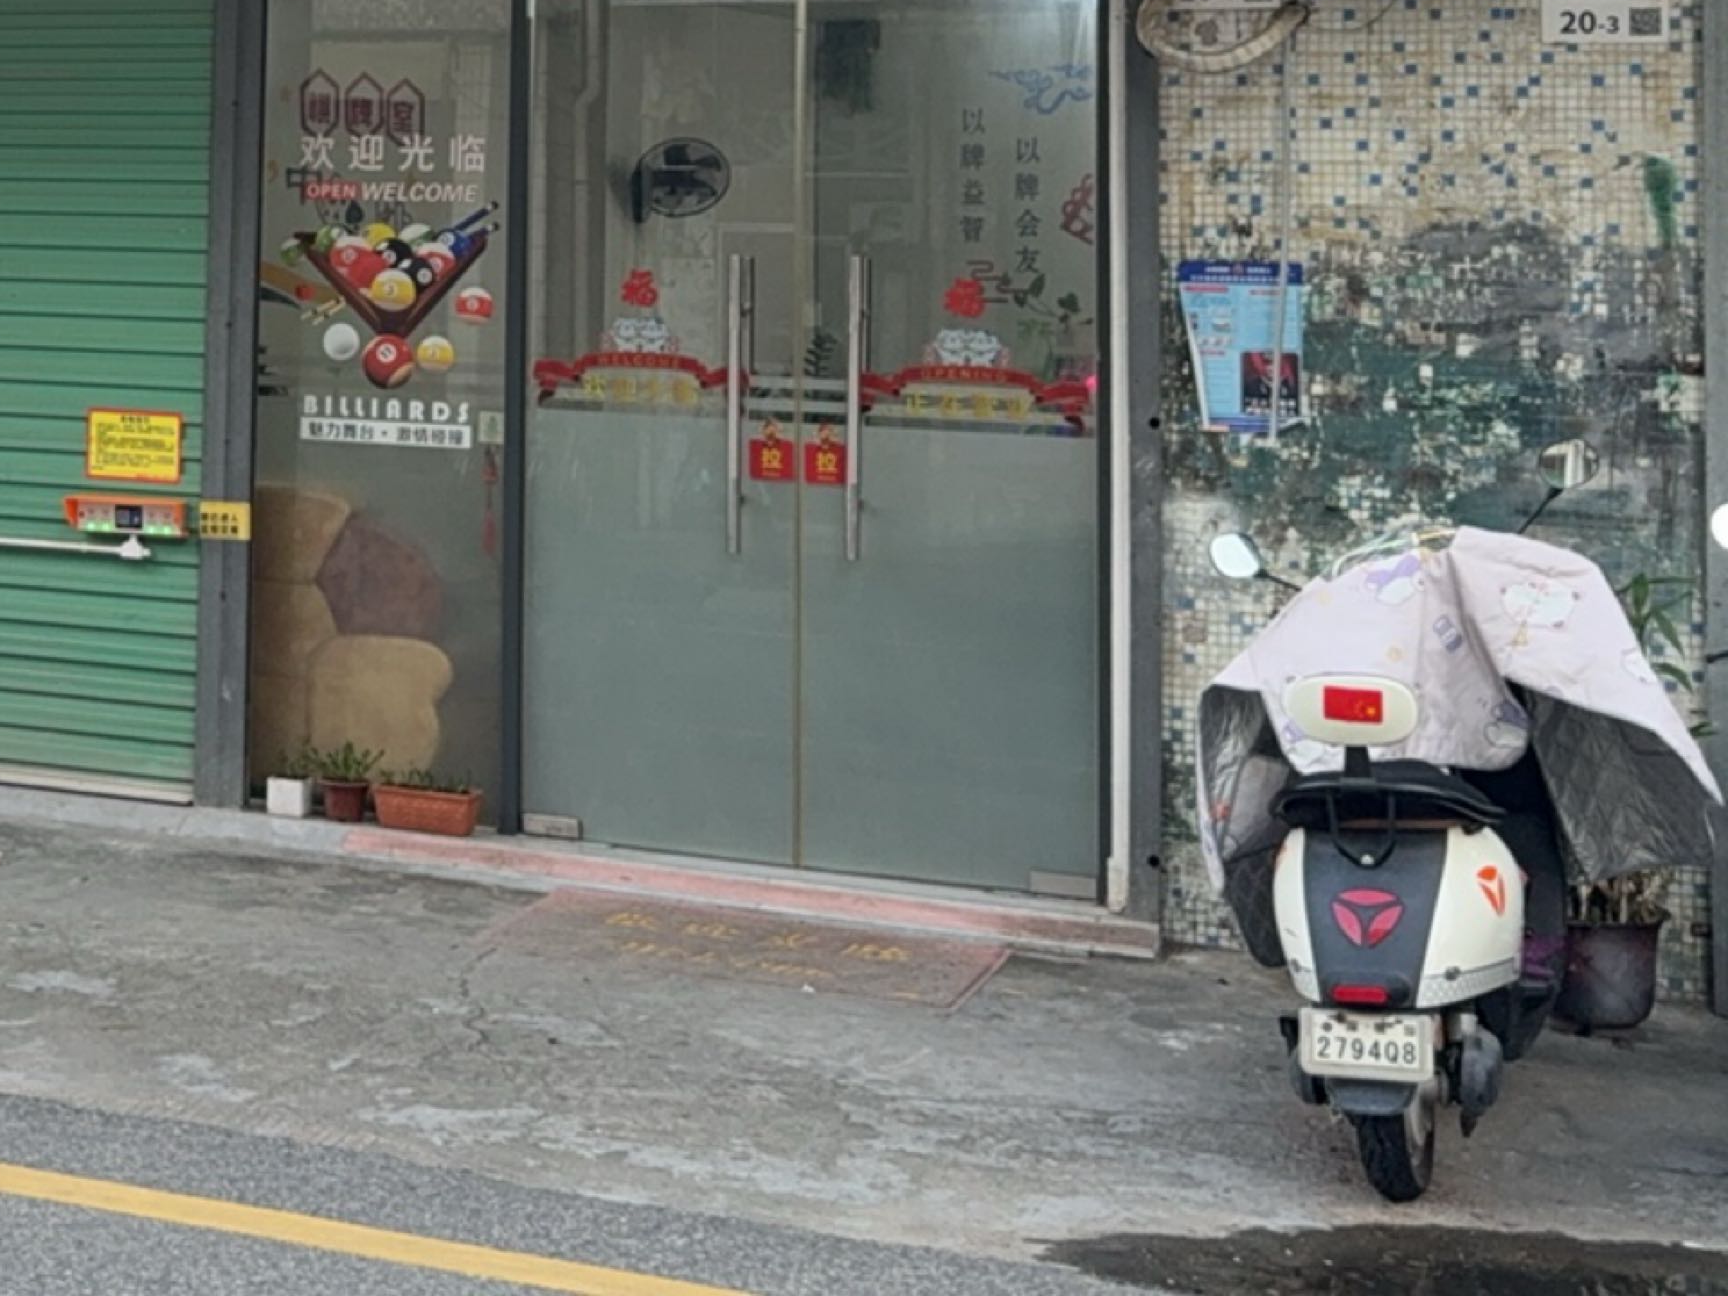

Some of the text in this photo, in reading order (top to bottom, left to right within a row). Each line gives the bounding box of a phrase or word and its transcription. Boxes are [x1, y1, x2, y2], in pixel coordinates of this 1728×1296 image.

[1560, 9, 1620, 36] 20-3
[299, 133, 486, 172] 欢迎光临
[306, 182, 478, 202] OPEN WELCOME
[1015, 137, 1041, 274] 以牌会友
[303, 394, 469, 423] BILLIARDS
